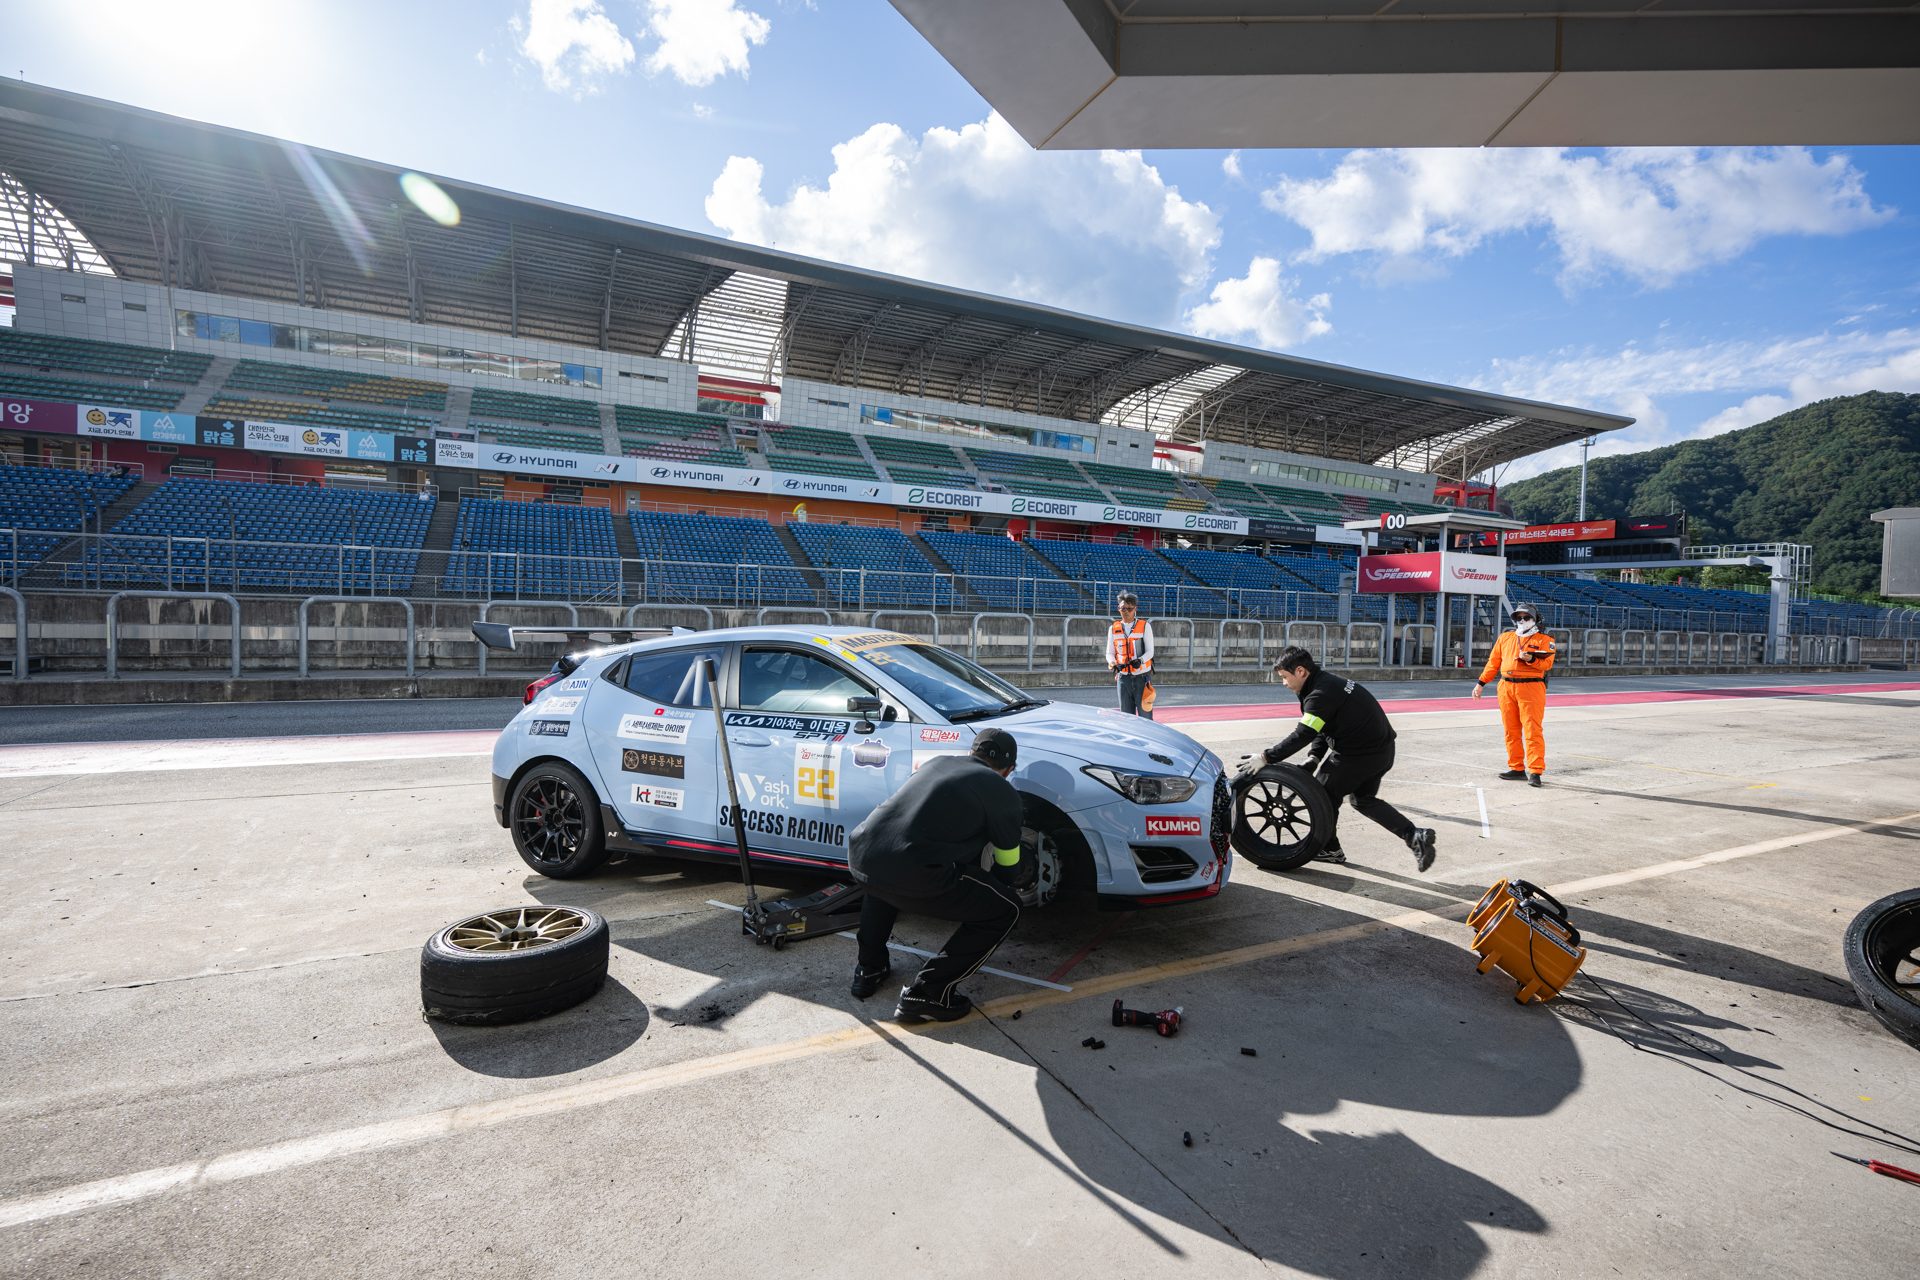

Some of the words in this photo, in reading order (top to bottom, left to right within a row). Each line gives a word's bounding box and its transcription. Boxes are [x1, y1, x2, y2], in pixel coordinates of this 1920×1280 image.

[248, 425, 275, 433] 대한민국
[248, 432, 271, 440] 스위스
[273, 434, 289, 442] 인제
[439, 443, 462, 451] 대한민국
[460, 451, 474, 459] 인제
[519, 456, 577, 469] HYUNDAI
[673, 470, 723, 482] HYUNDAI
[803, 482, 847, 493] HYUNDAI
[926, 491, 982, 507] ECORBIT
[1027, 501, 1078, 516] ECORBIT
[1117, 510, 1162, 523] ECORBIT
[1387, 514, 1405, 529] 00
[1197, 517, 1238, 530] ECORBIT
[1508, 532, 1519, 540] GT
[1520, 529, 1547, 539] 마스터즈
[1548, 527, 1575, 537] 4라운드
[1568, 546, 1592, 558] TIME
[1366, 568, 1432, 581] SPEEDIUM
[1452, 566, 1498, 581] SPEEDIUM
[569, 680, 588, 689] AJIN
[766, 717, 805, 730] 기아차는
[798, 767, 835, 801] 22
[636, 786, 651, 803] kt
[787, 816, 845, 847] RACING
[1148, 820, 1200, 832] KUMHO
